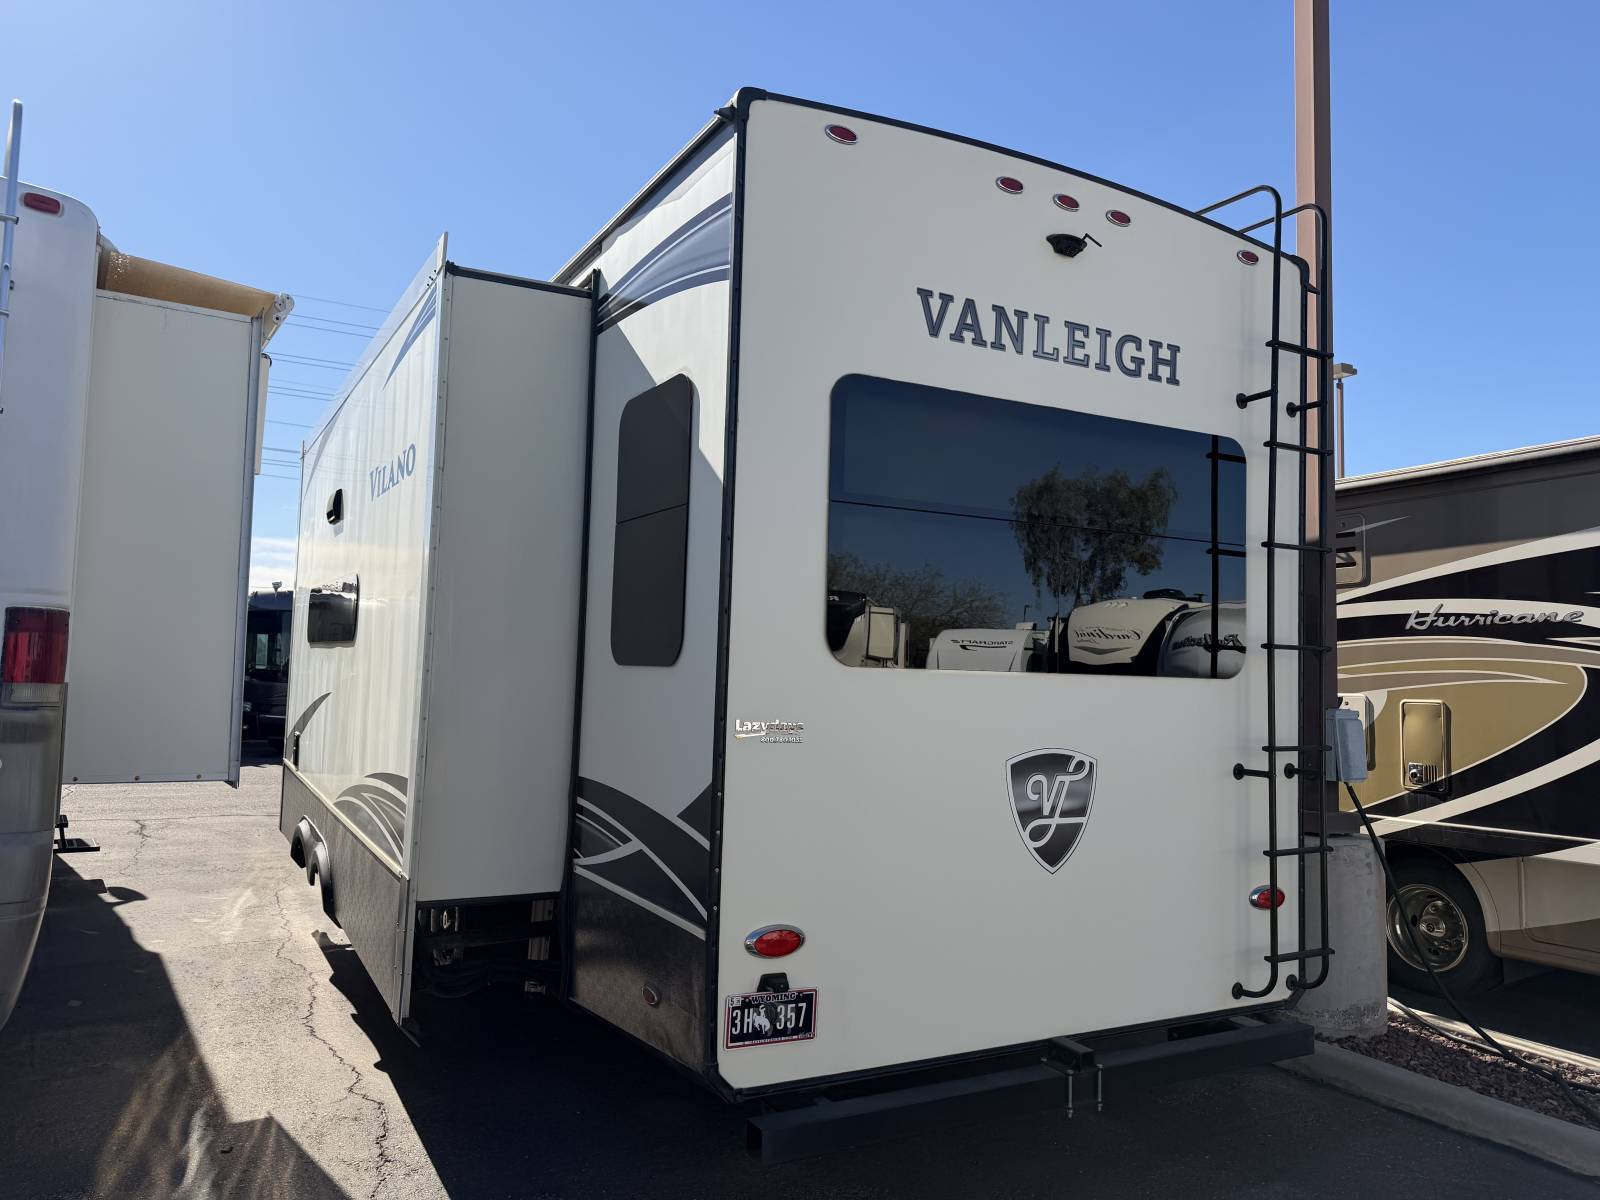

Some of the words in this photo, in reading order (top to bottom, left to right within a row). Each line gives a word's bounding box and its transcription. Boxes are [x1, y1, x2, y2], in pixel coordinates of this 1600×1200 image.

[916, 287, 1180, 386] VANLEIGH
[1404, 603, 1585, 631] Hurricane
[751, 992, 797, 1005] WYOMING
[776, 1003, 807, 1030] 357
